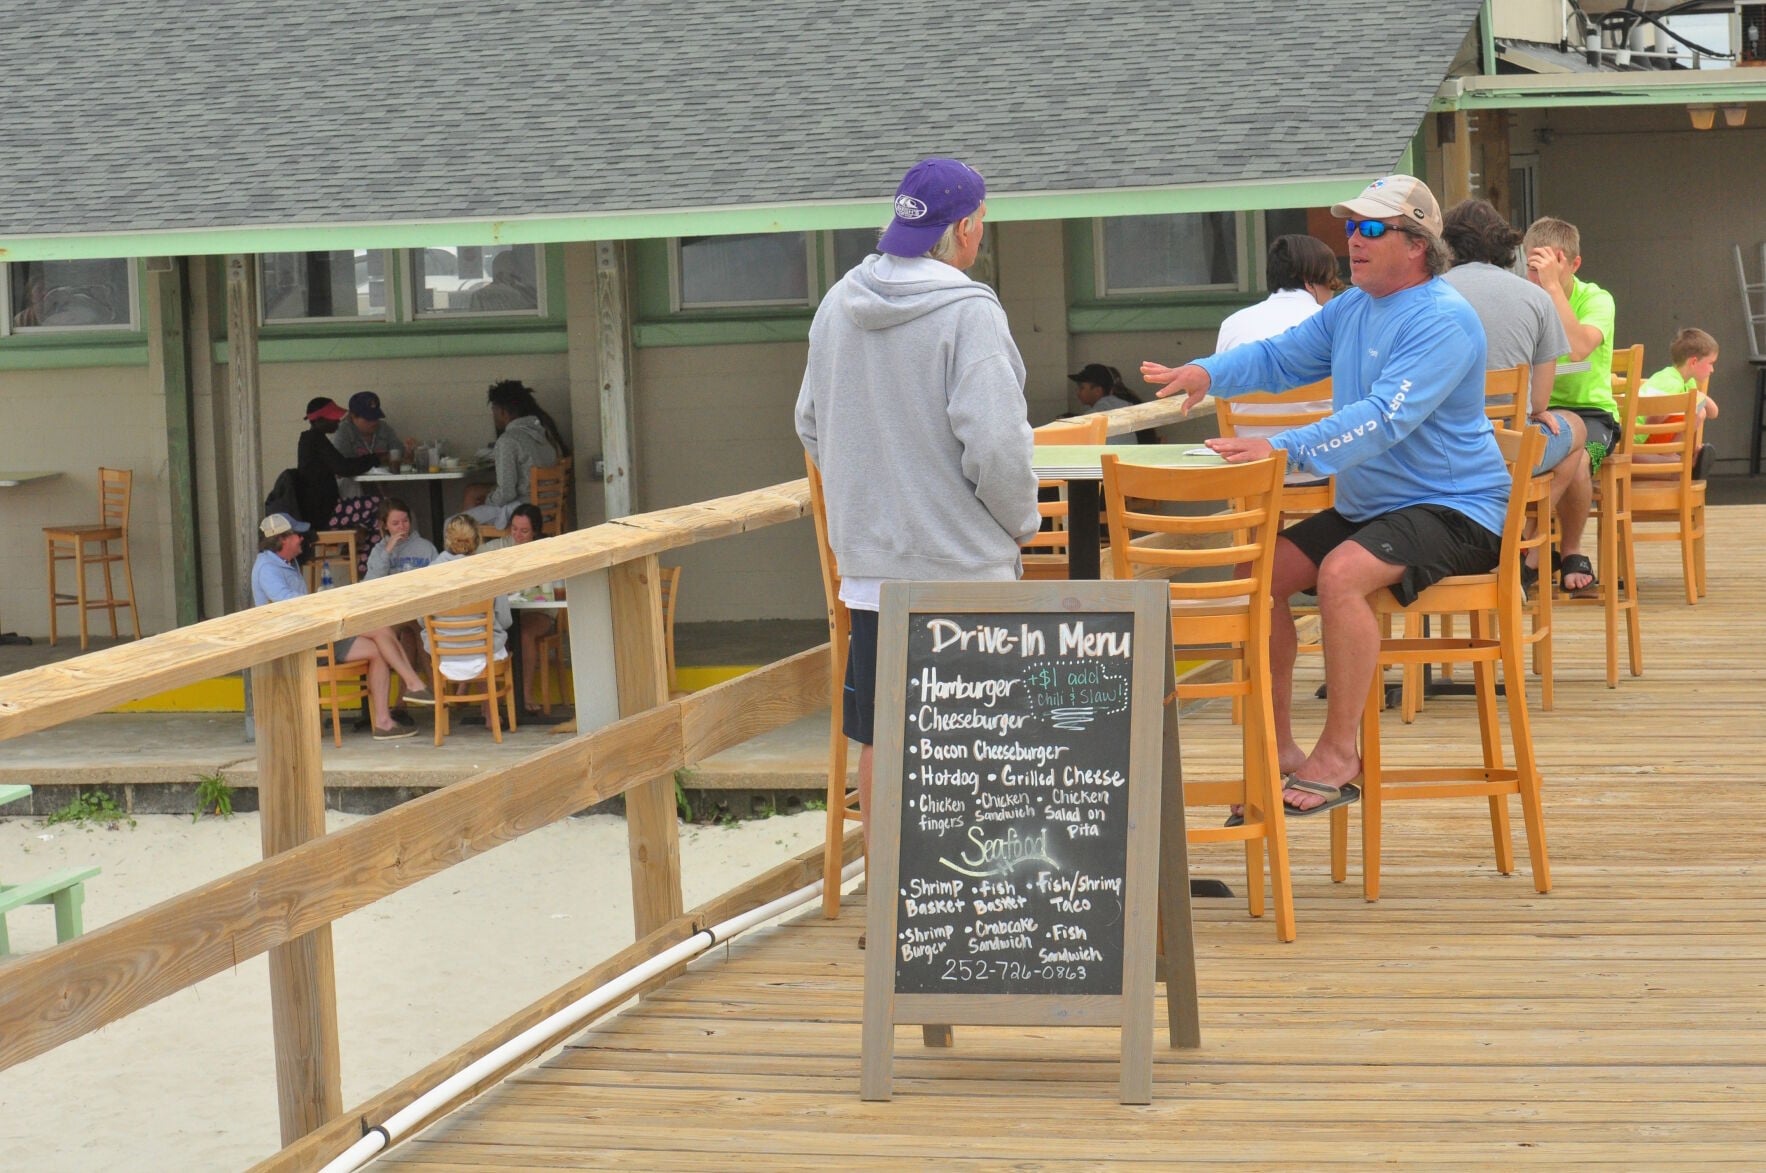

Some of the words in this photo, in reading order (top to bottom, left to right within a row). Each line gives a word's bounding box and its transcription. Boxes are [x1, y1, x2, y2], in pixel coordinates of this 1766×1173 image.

[927, 619, 1045, 657] Drive-In
[1059, 621, 1131, 658] Menu
[1067, 666, 1099, 685] add
[921, 667, 1020, 707] Hamburger
[918, 705, 1030, 736] Cheeseburger
[921, 738, 968, 760] Bacon
[973, 739, 1070, 767] Cheeseburger
[921, 765, 980, 795] Hotdog
[1001, 764, 1055, 787] Grilled
[1063, 766, 1125, 787] Cheese
[919, 794, 966, 813] Chicken
[981, 792, 1030, 809] Chicken
[1052, 788, 1110, 805] Chicken
[1044, 805, 1081, 822] Salad
[1087, 809, 1106, 821] on
[960, 825, 1049, 867] Seafood
[910, 878, 964, 899] Shrimp
[905, 898, 966, 918] Basket
[973, 895, 1028, 916] Basket
[1049, 896, 1092, 914] Taco
[975, 917, 1039, 938] Crabcake
[1052, 924, 1087, 941] Fish
[901, 941, 947, 965] Burger
[968, 934, 1033, 954] Sandwich
[1038, 946, 1104, 964] Sandwich
[941, 958, 1087, 981] 252-726-0863
